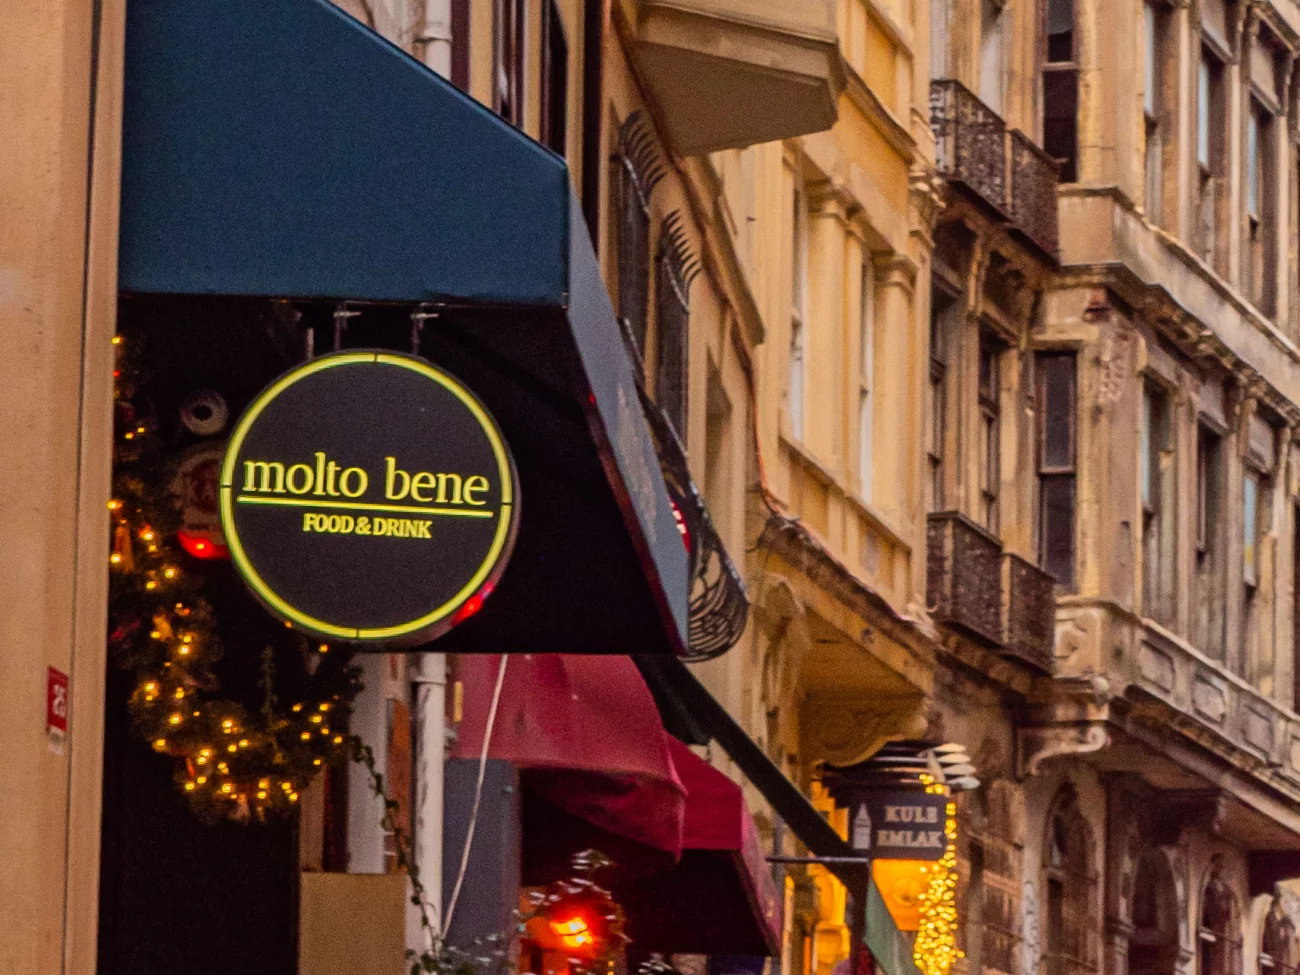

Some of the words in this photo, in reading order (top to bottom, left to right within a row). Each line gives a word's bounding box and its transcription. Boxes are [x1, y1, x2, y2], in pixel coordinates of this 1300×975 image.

[243, 452, 368, 497] molto
[385, 456, 489, 506] bene
[884, 805, 937, 823] KULE
[877, 830, 943, 848] EMLAK
